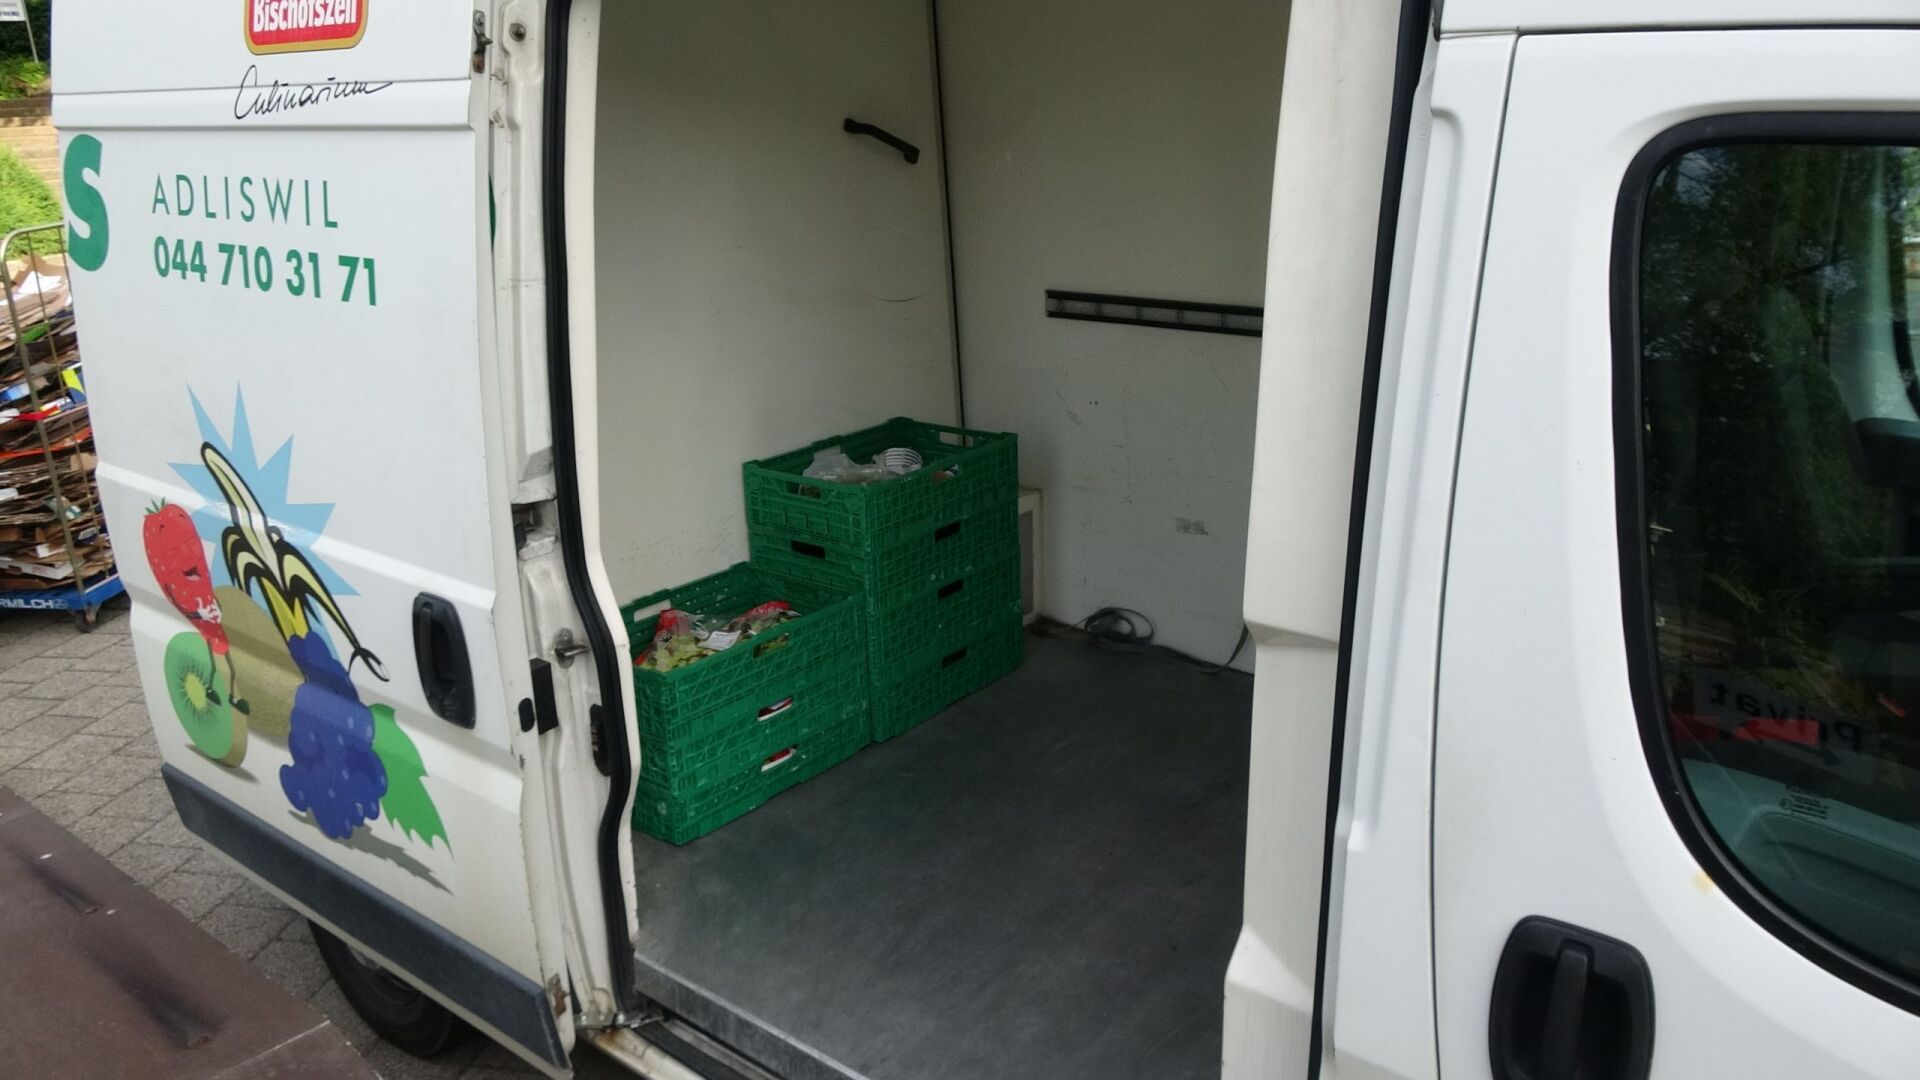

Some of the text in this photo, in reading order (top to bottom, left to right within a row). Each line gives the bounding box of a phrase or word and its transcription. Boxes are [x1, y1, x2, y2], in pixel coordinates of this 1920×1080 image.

[234, 65, 393, 120] Culinarium
[152, 174, 338, 228] ADLISWIL
[154, 237, 377, 306] 044 710 31 71
